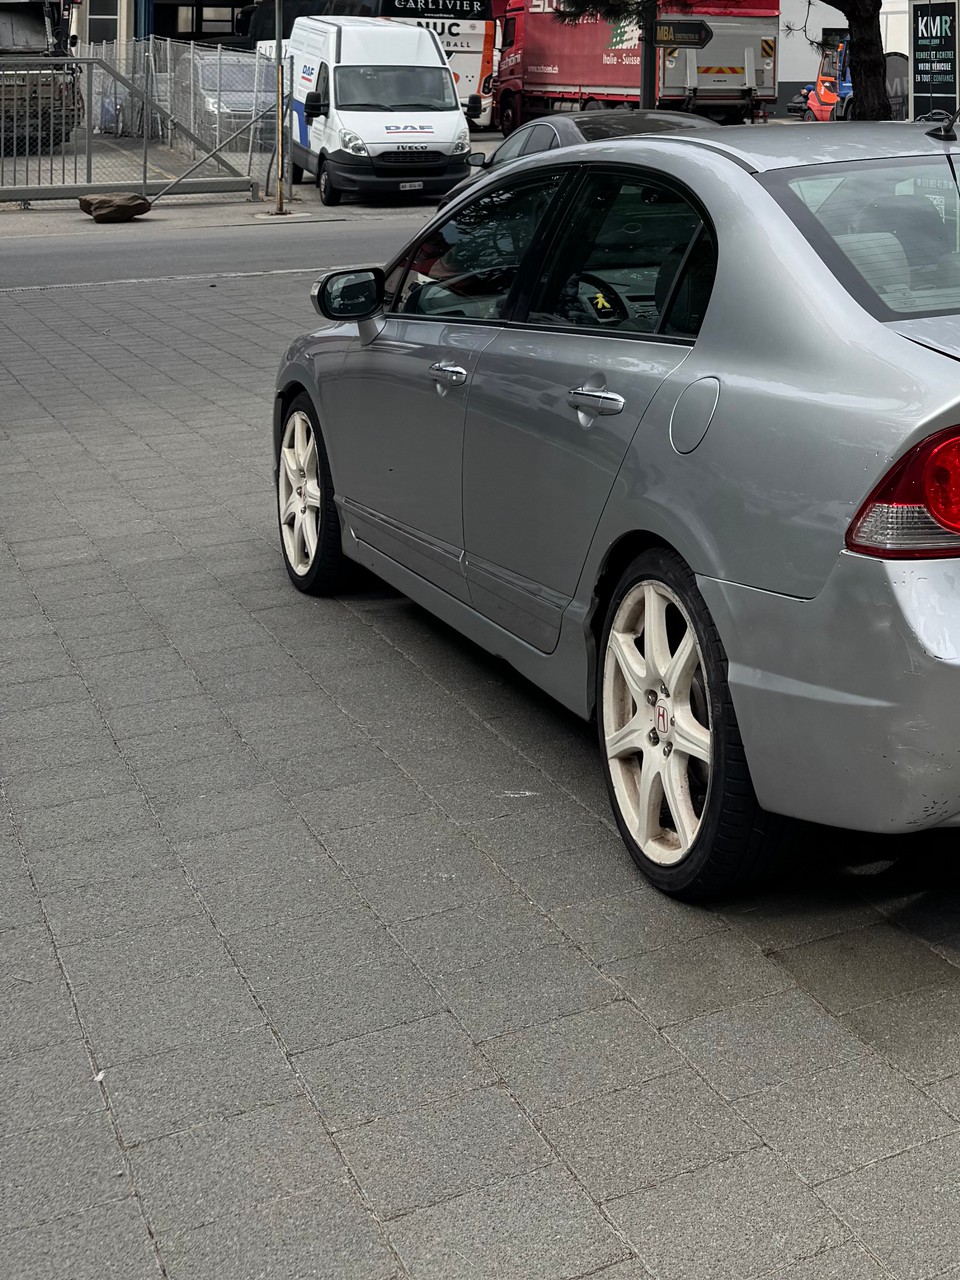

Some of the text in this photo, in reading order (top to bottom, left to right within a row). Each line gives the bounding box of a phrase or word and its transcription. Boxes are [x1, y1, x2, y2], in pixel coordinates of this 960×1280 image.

[918, 15, 952, 37] KMR
[656, 26, 675, 40] MBA
[603, 53, 617, 65] Italie
[622, 53, 640, 65] Suisse
[930, 51, 936, 59] ET
[302, 65, 315, 76] DAF
